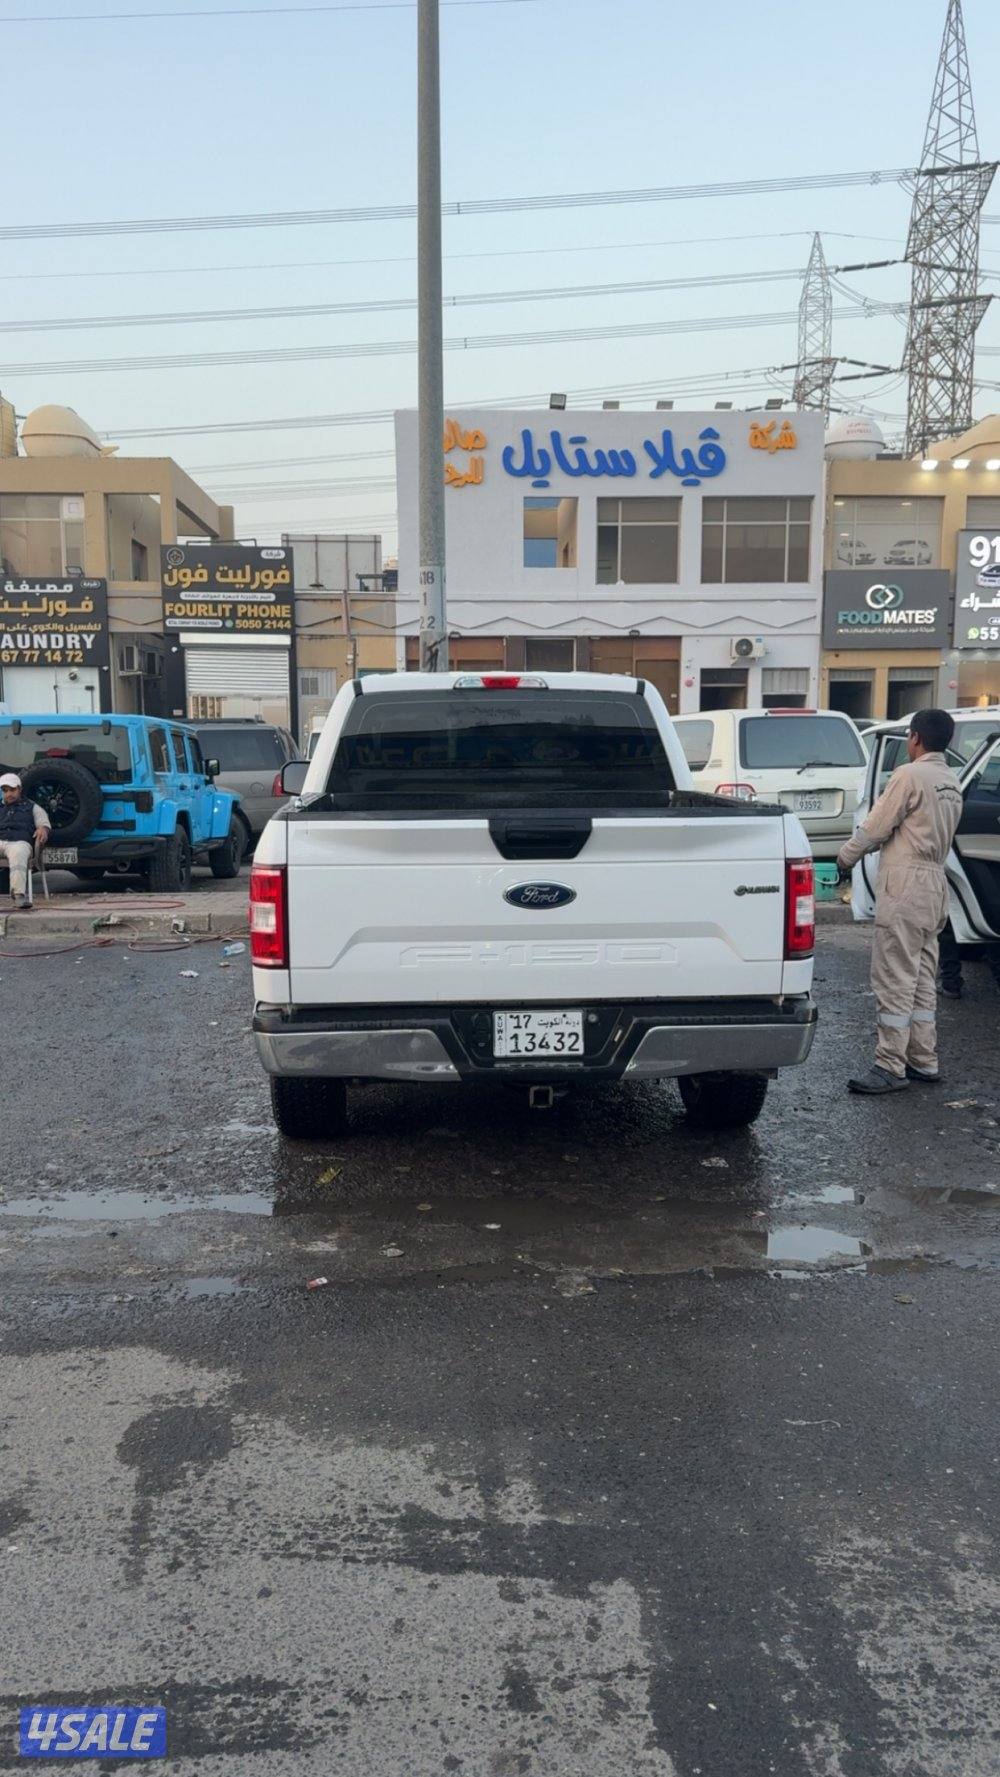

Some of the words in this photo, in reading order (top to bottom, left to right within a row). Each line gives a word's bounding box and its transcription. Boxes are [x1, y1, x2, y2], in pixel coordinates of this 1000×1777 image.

[748, 419, 797, 454] شركة
[502, 428, 637, 488] ستايل
[164, 563, 208, 588] فون
[215, 564, 290, 590] فورليت
[4, 580, 74, 596] مصبغة
[165, 602, 232, 617] FOURLIT
[237, 604, 292, 618] PHONE
[235, 619, 262, 629] 5050
[264, 619, 292, 629] 2144
[1, 650, 19, 663] 67
[23, 650, 40, 663] 77
[44, 650, 62, 663] 14
[65, 650, 84, 663] 72
[521, 886, 560, 903] Ford
[513, 1014, 532, 1029] 17
[509, 1032, 580, 1053] 13432
